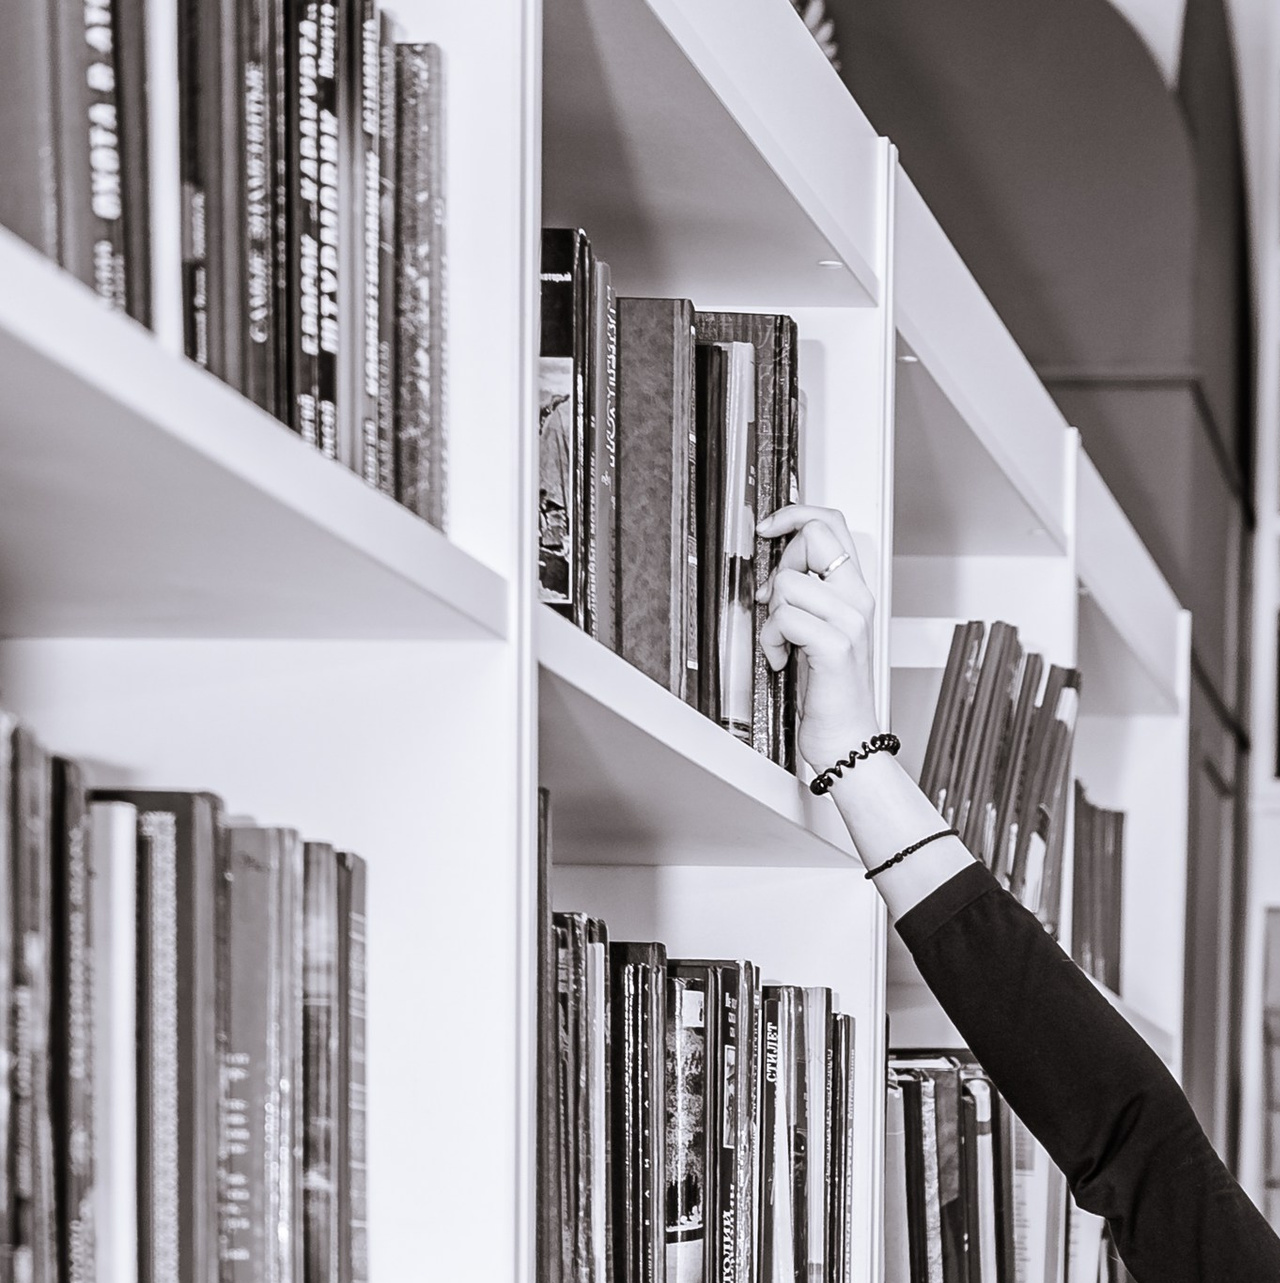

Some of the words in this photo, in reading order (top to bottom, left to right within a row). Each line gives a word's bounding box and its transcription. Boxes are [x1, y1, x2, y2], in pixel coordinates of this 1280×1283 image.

[84, 0, 113, 52] АТ
[319, 109, 339, 356] ШТУРМОВИК
[766, 1021, 778, 1082] СТИЛЕТ
